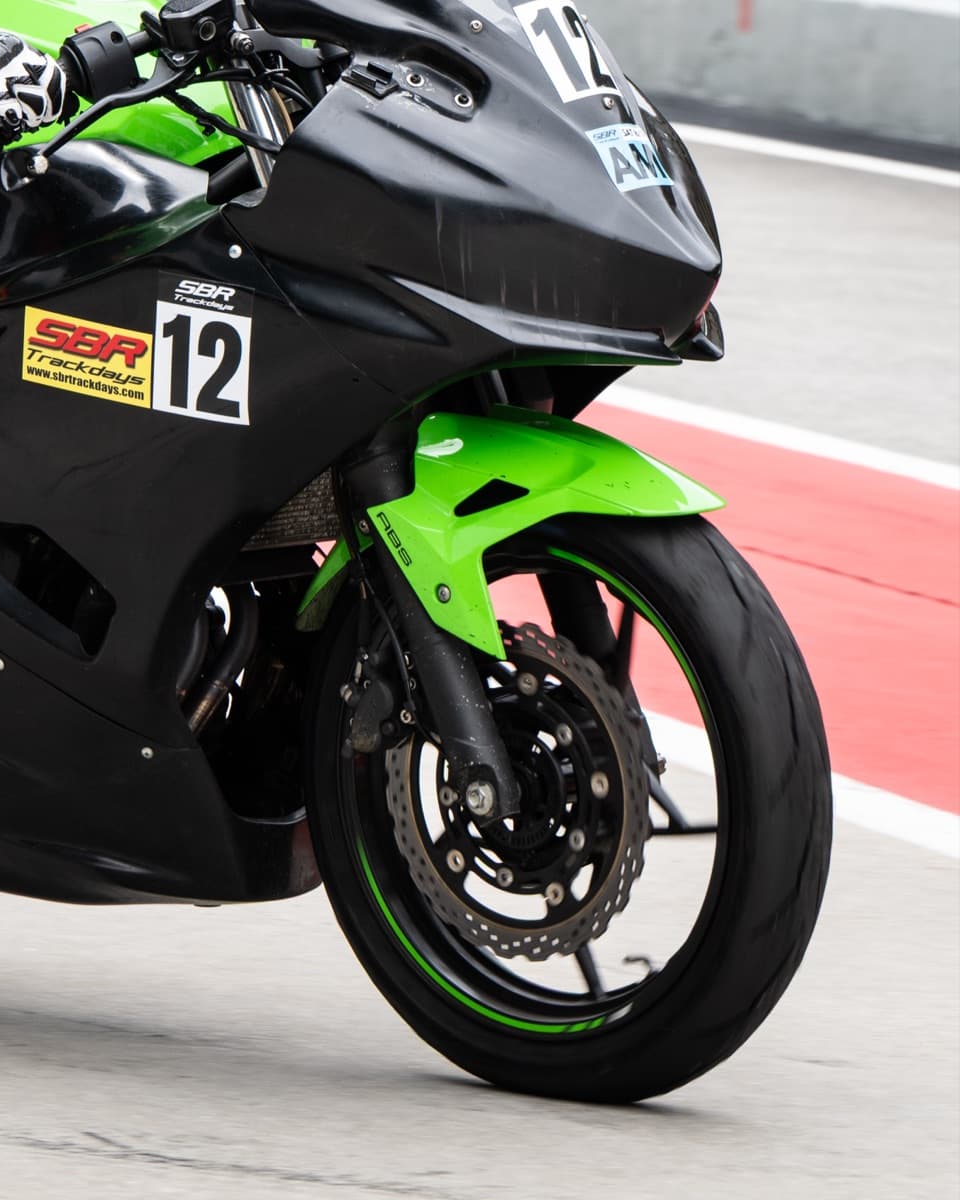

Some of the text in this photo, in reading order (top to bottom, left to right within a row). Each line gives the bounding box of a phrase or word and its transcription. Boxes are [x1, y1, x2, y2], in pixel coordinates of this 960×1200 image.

[530, 5, 617, 93] 12
[610, 143, 667, 184] AM
[174, 279, 236, 302] SBR
[174, 293, 235, 311] Trackdays
[28, 317, 148, 369] SBR
[26, 365, 145, 401] www.sbrtrackdays.com
[27, 347, 146, 386] Trackdays
[162, 313, 242, 418] 12
[376, 511, 413, 567] ABS
